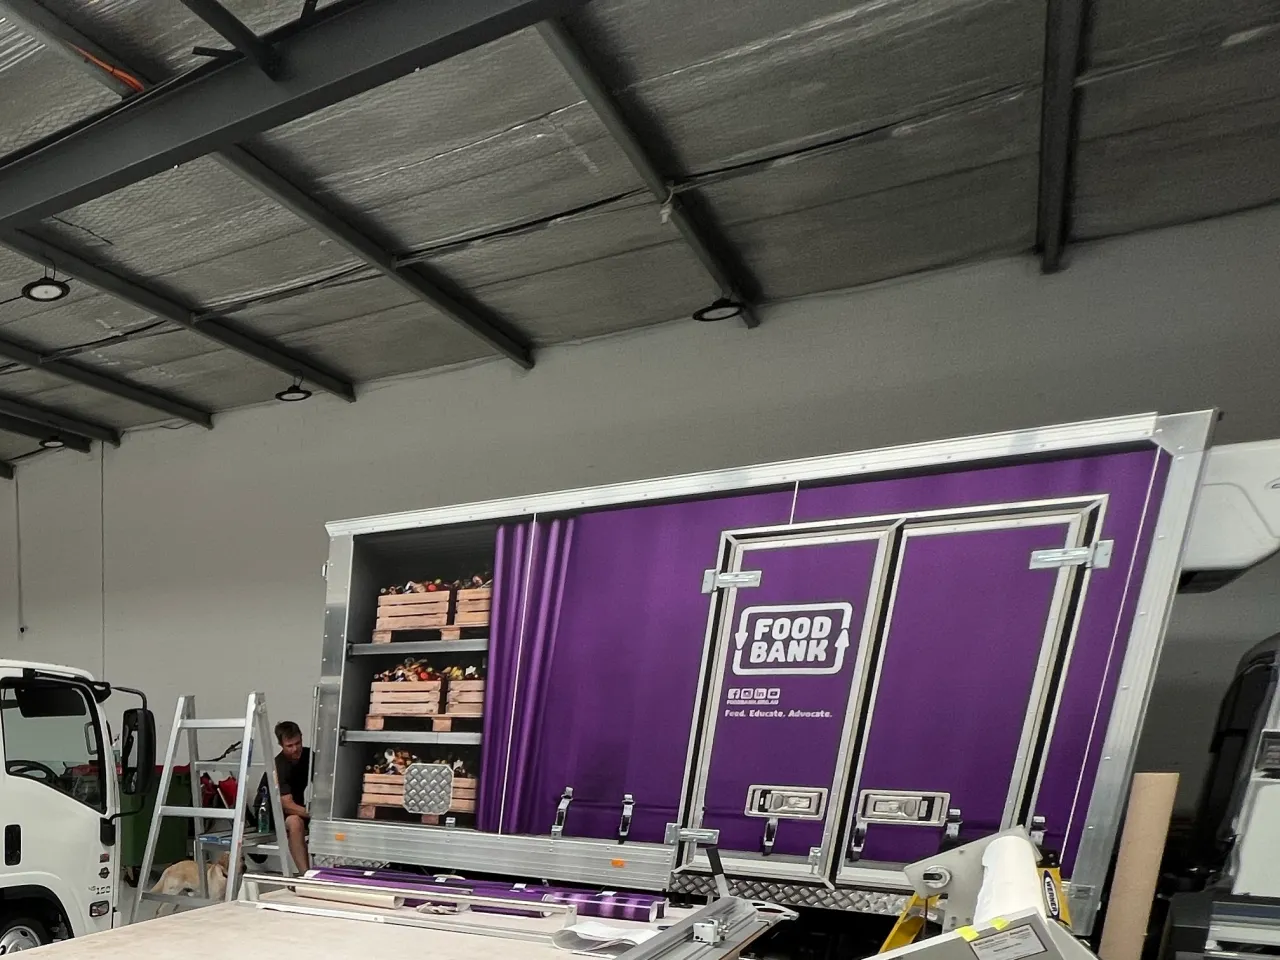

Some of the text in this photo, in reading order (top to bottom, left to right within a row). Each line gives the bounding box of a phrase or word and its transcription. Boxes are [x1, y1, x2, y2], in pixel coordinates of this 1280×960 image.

[753, 616, 832, 640] FOOD
[749, 639, 829, 664] BANK
[724, 709, 832, 718] Feed. Educate. Advocate.
[1045, 880, 1058, 911] WERNER
